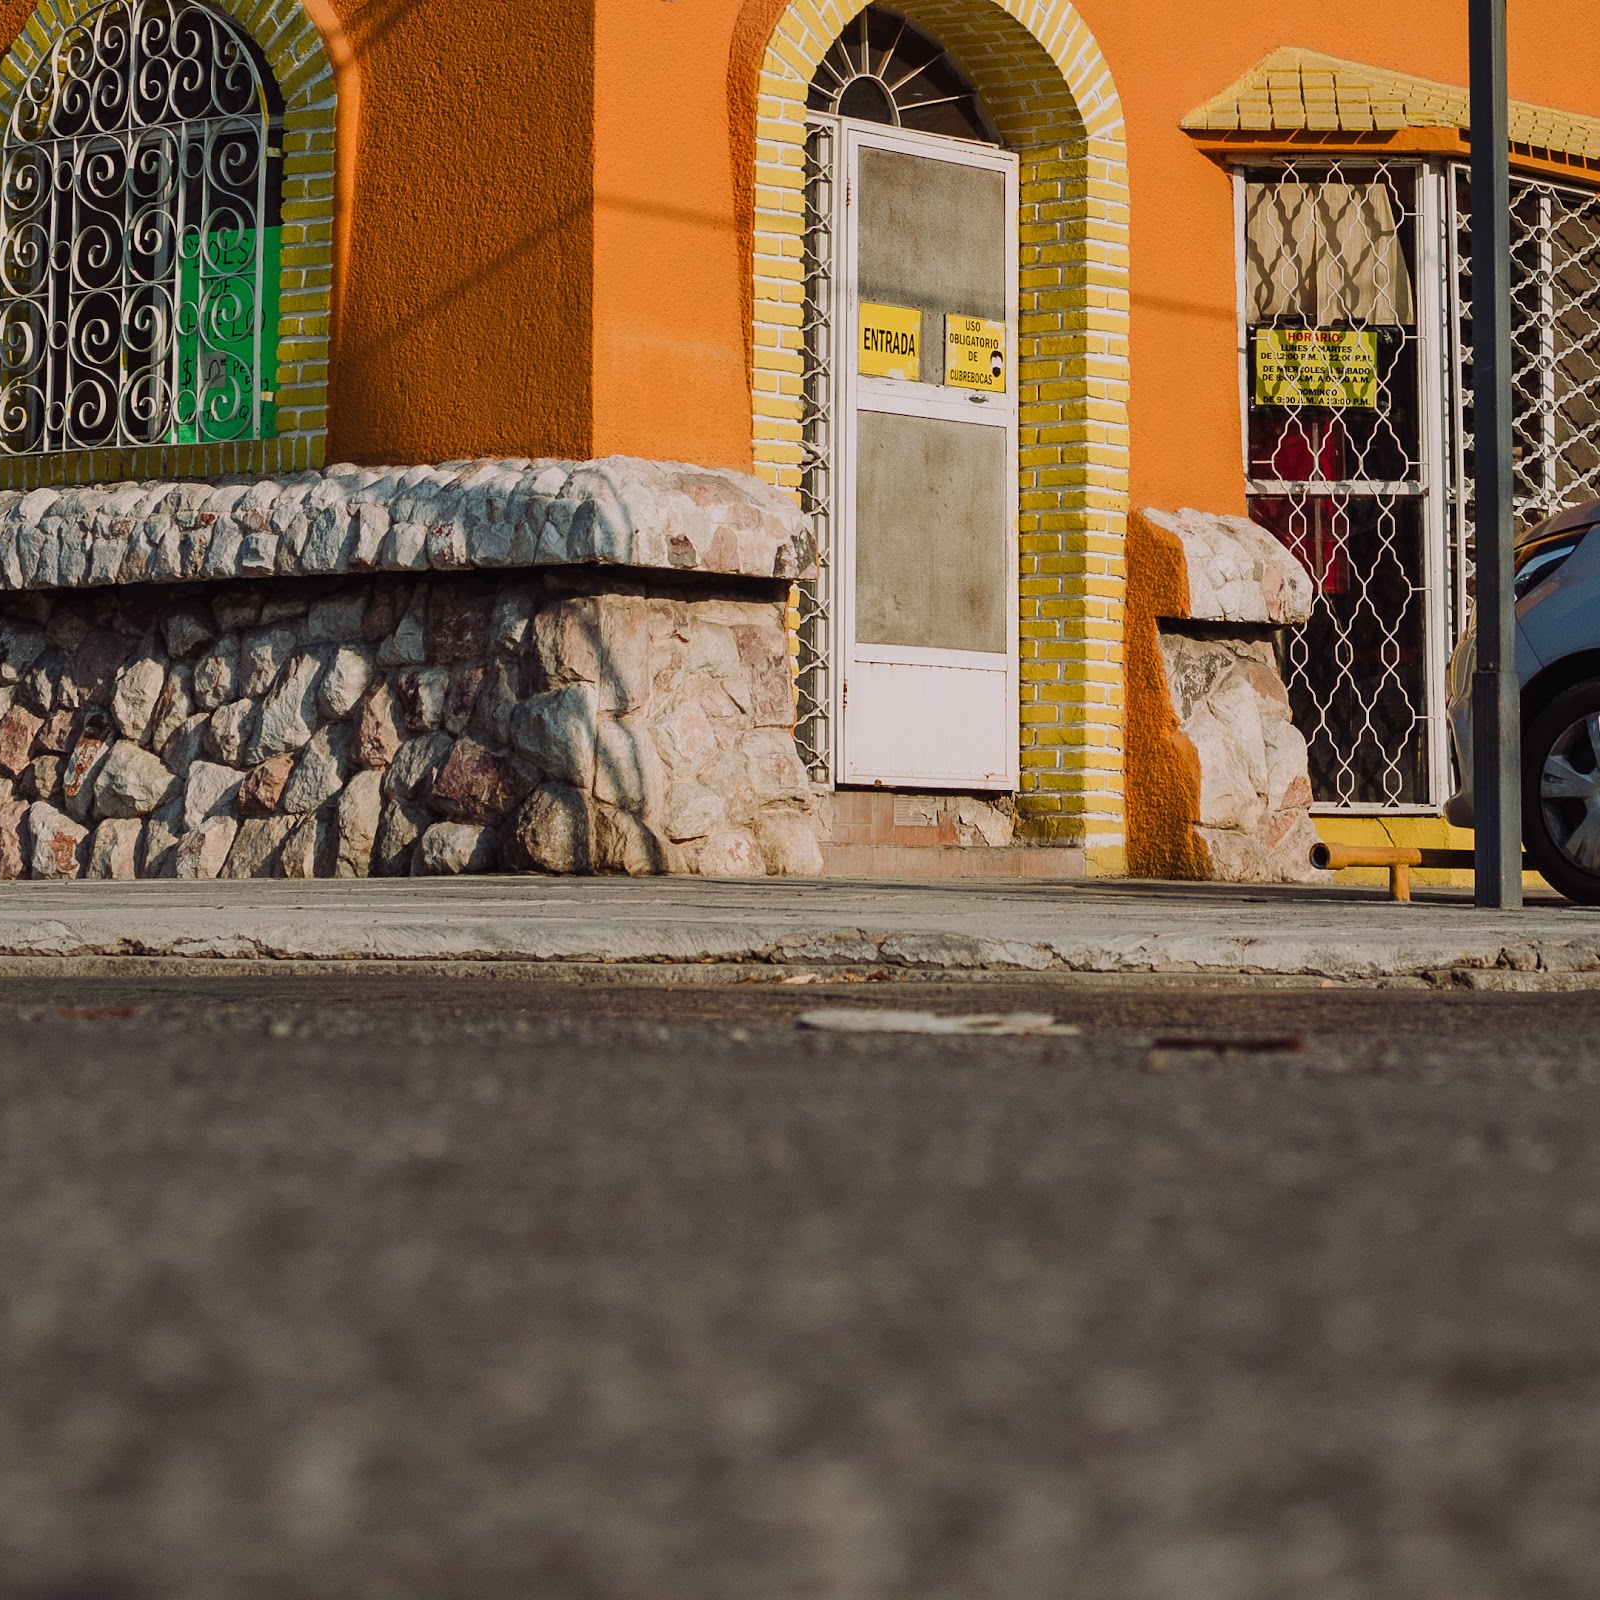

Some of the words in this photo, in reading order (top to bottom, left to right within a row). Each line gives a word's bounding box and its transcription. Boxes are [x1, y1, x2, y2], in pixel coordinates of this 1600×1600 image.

[965, 320, 981, 333] USO
[864, 327, 916, 357] ENTRADA
[949, 333, 999, 350] OBLIGATORIO
[1288, 332, 1343, 343] HORARIO:
[1281, 344, 1308, 352] LUNES
[968, 351, 979, 362] DE
[950, 368, 993, 385] CUBREBOCAS
[1353, 376, 1371, 384] A.M.
[1263, 396, 1275, 404] DE
